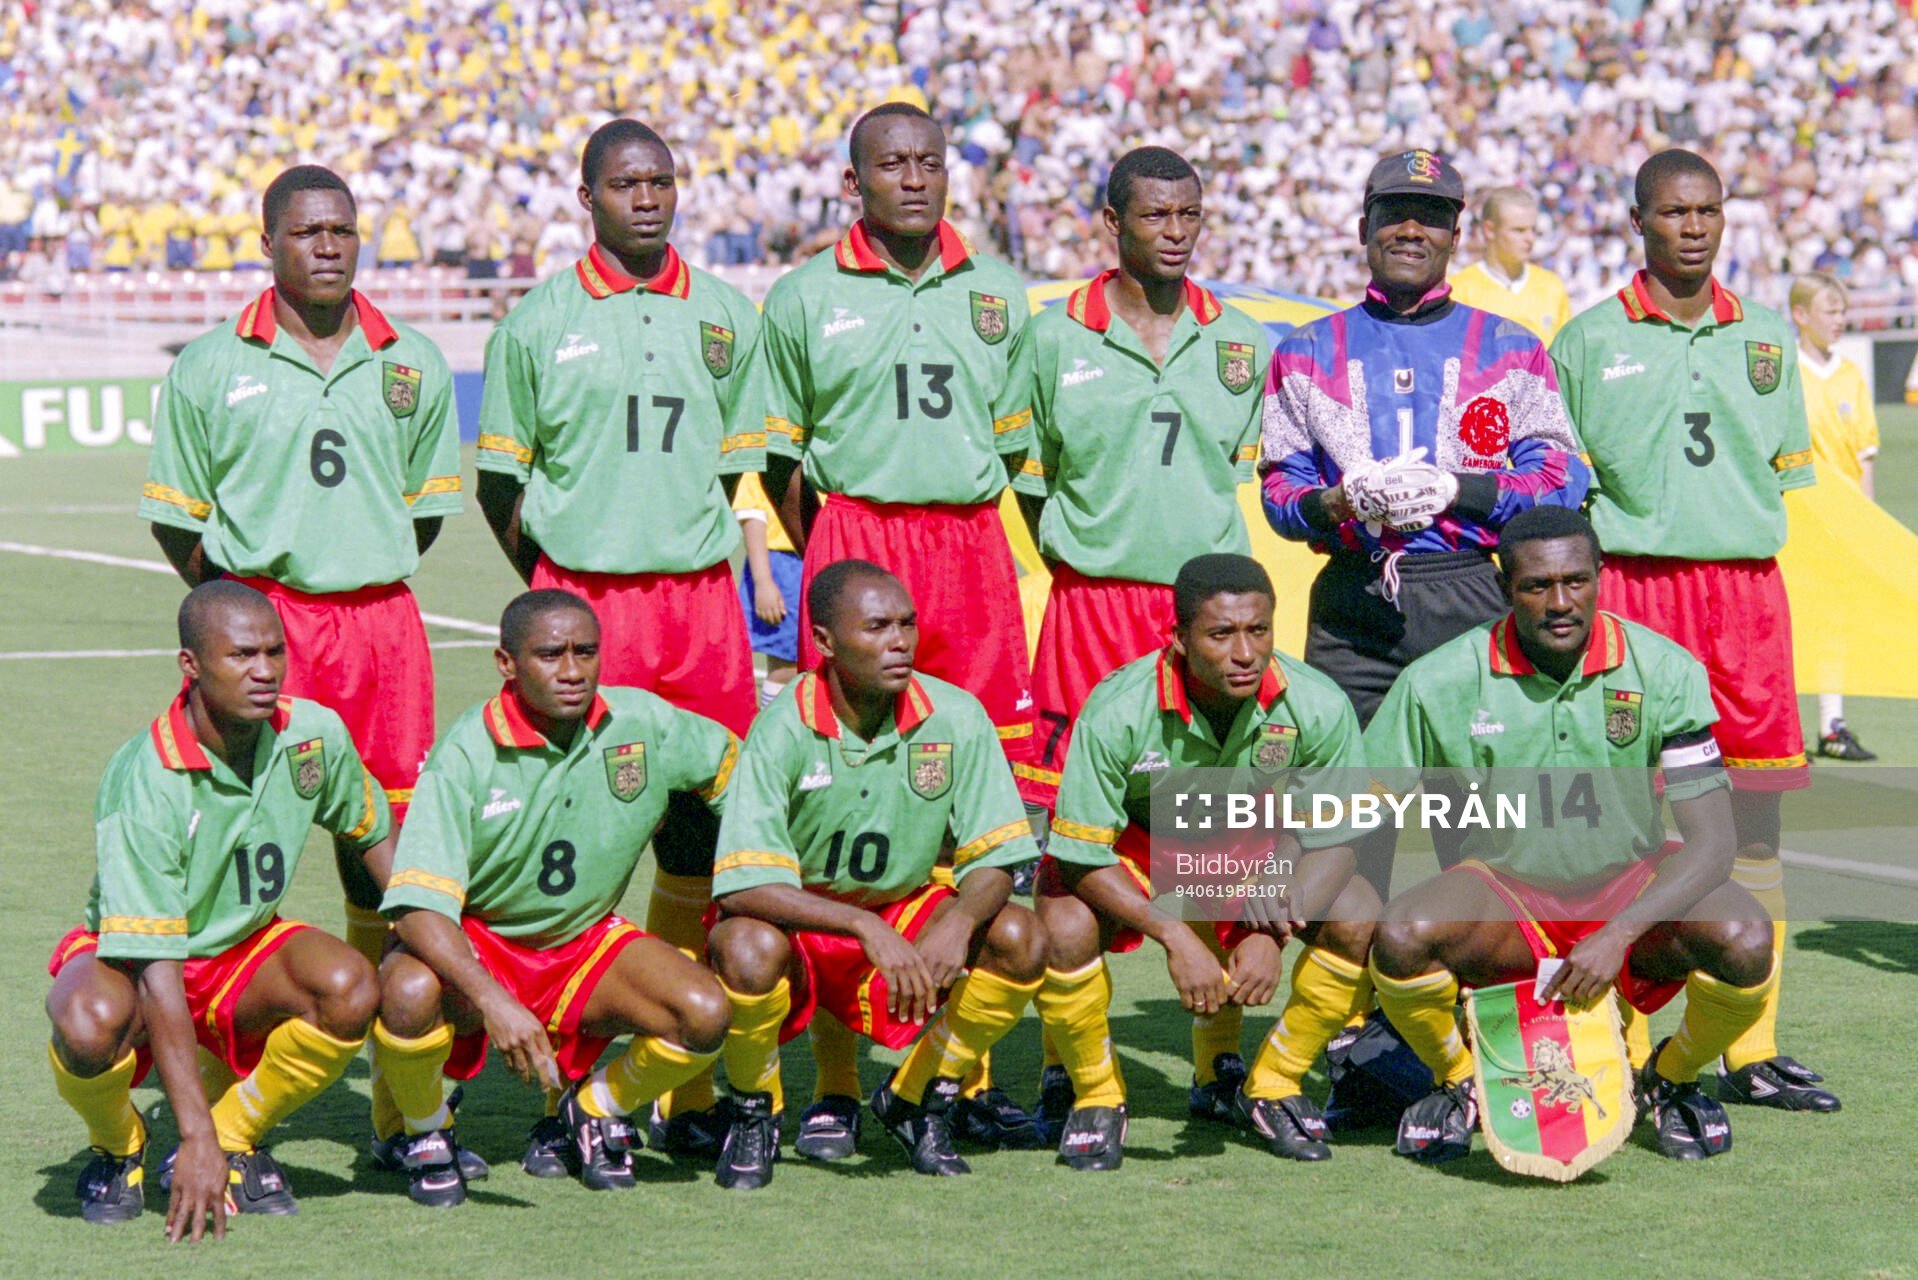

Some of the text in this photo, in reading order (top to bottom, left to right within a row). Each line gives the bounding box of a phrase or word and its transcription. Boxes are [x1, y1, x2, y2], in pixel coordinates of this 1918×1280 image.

[895, 363, 953, 420] 13
[627, 395, 685, 453] 17
[1151, 412, 1182, 466] 7
[1397, 408, 1414, 458] 1
[1684, 412, 1715, 467] 3
[310, 429, 347, 488] 6
[1039, 709, 1069, 767] 7
[1538, 773, 1602, 829] 14
[235, 843, 285, 906] 19
[537, 839, 576, 897] 8
[813, 830, 890, 883] 10
